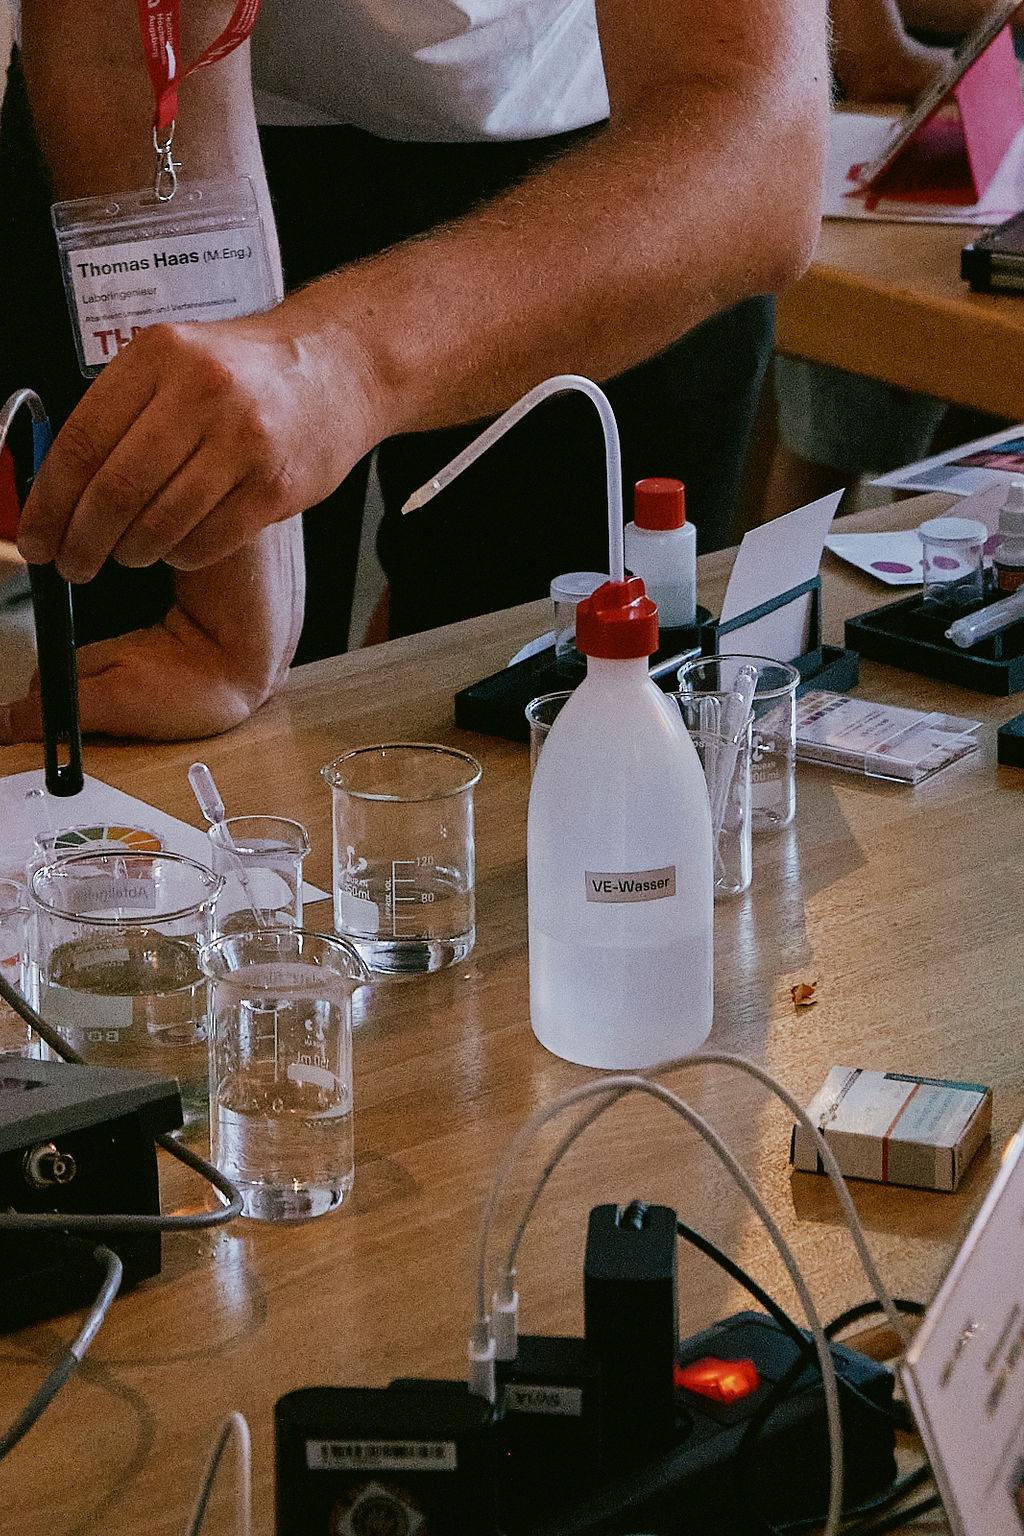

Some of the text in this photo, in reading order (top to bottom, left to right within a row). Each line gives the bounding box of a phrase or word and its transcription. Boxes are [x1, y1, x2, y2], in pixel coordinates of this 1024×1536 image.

[77, 245, 252, 278] Thomas Haas (M.Eng.)
[592, 878, 670, 893] VE-Wasser
[421, 892, 435, 903] 80
